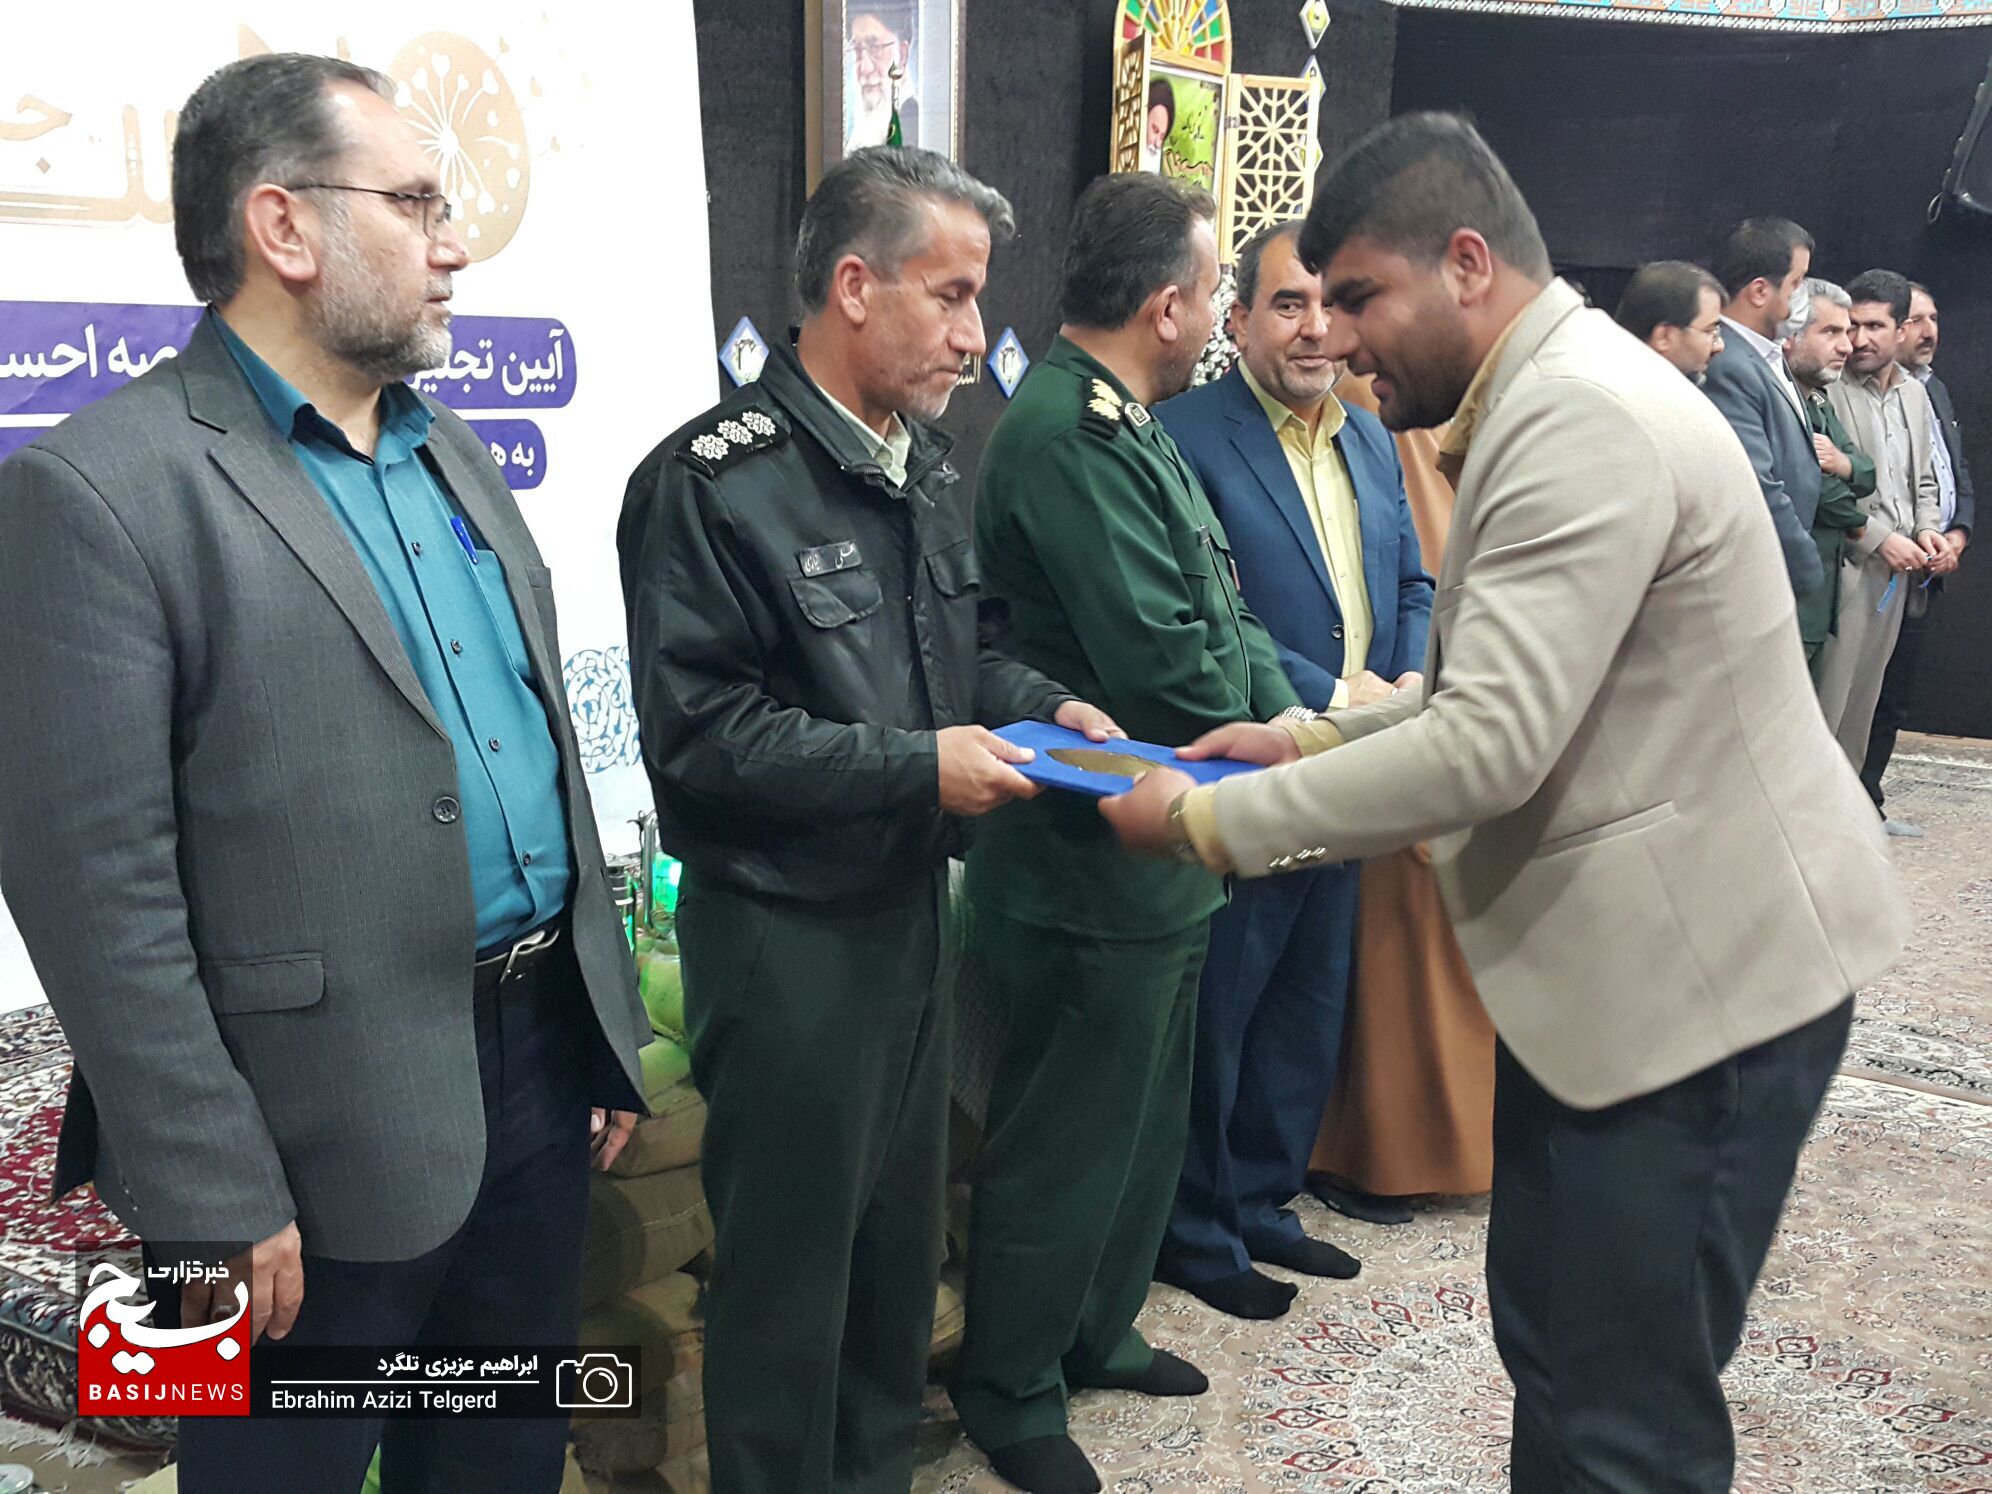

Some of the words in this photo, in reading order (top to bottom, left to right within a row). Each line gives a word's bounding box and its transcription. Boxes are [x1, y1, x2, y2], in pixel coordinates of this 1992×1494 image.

[0, 323, 98, 378] احس
[502, 328, 564, 396] آیین
[511, 441, 535, 477] به
